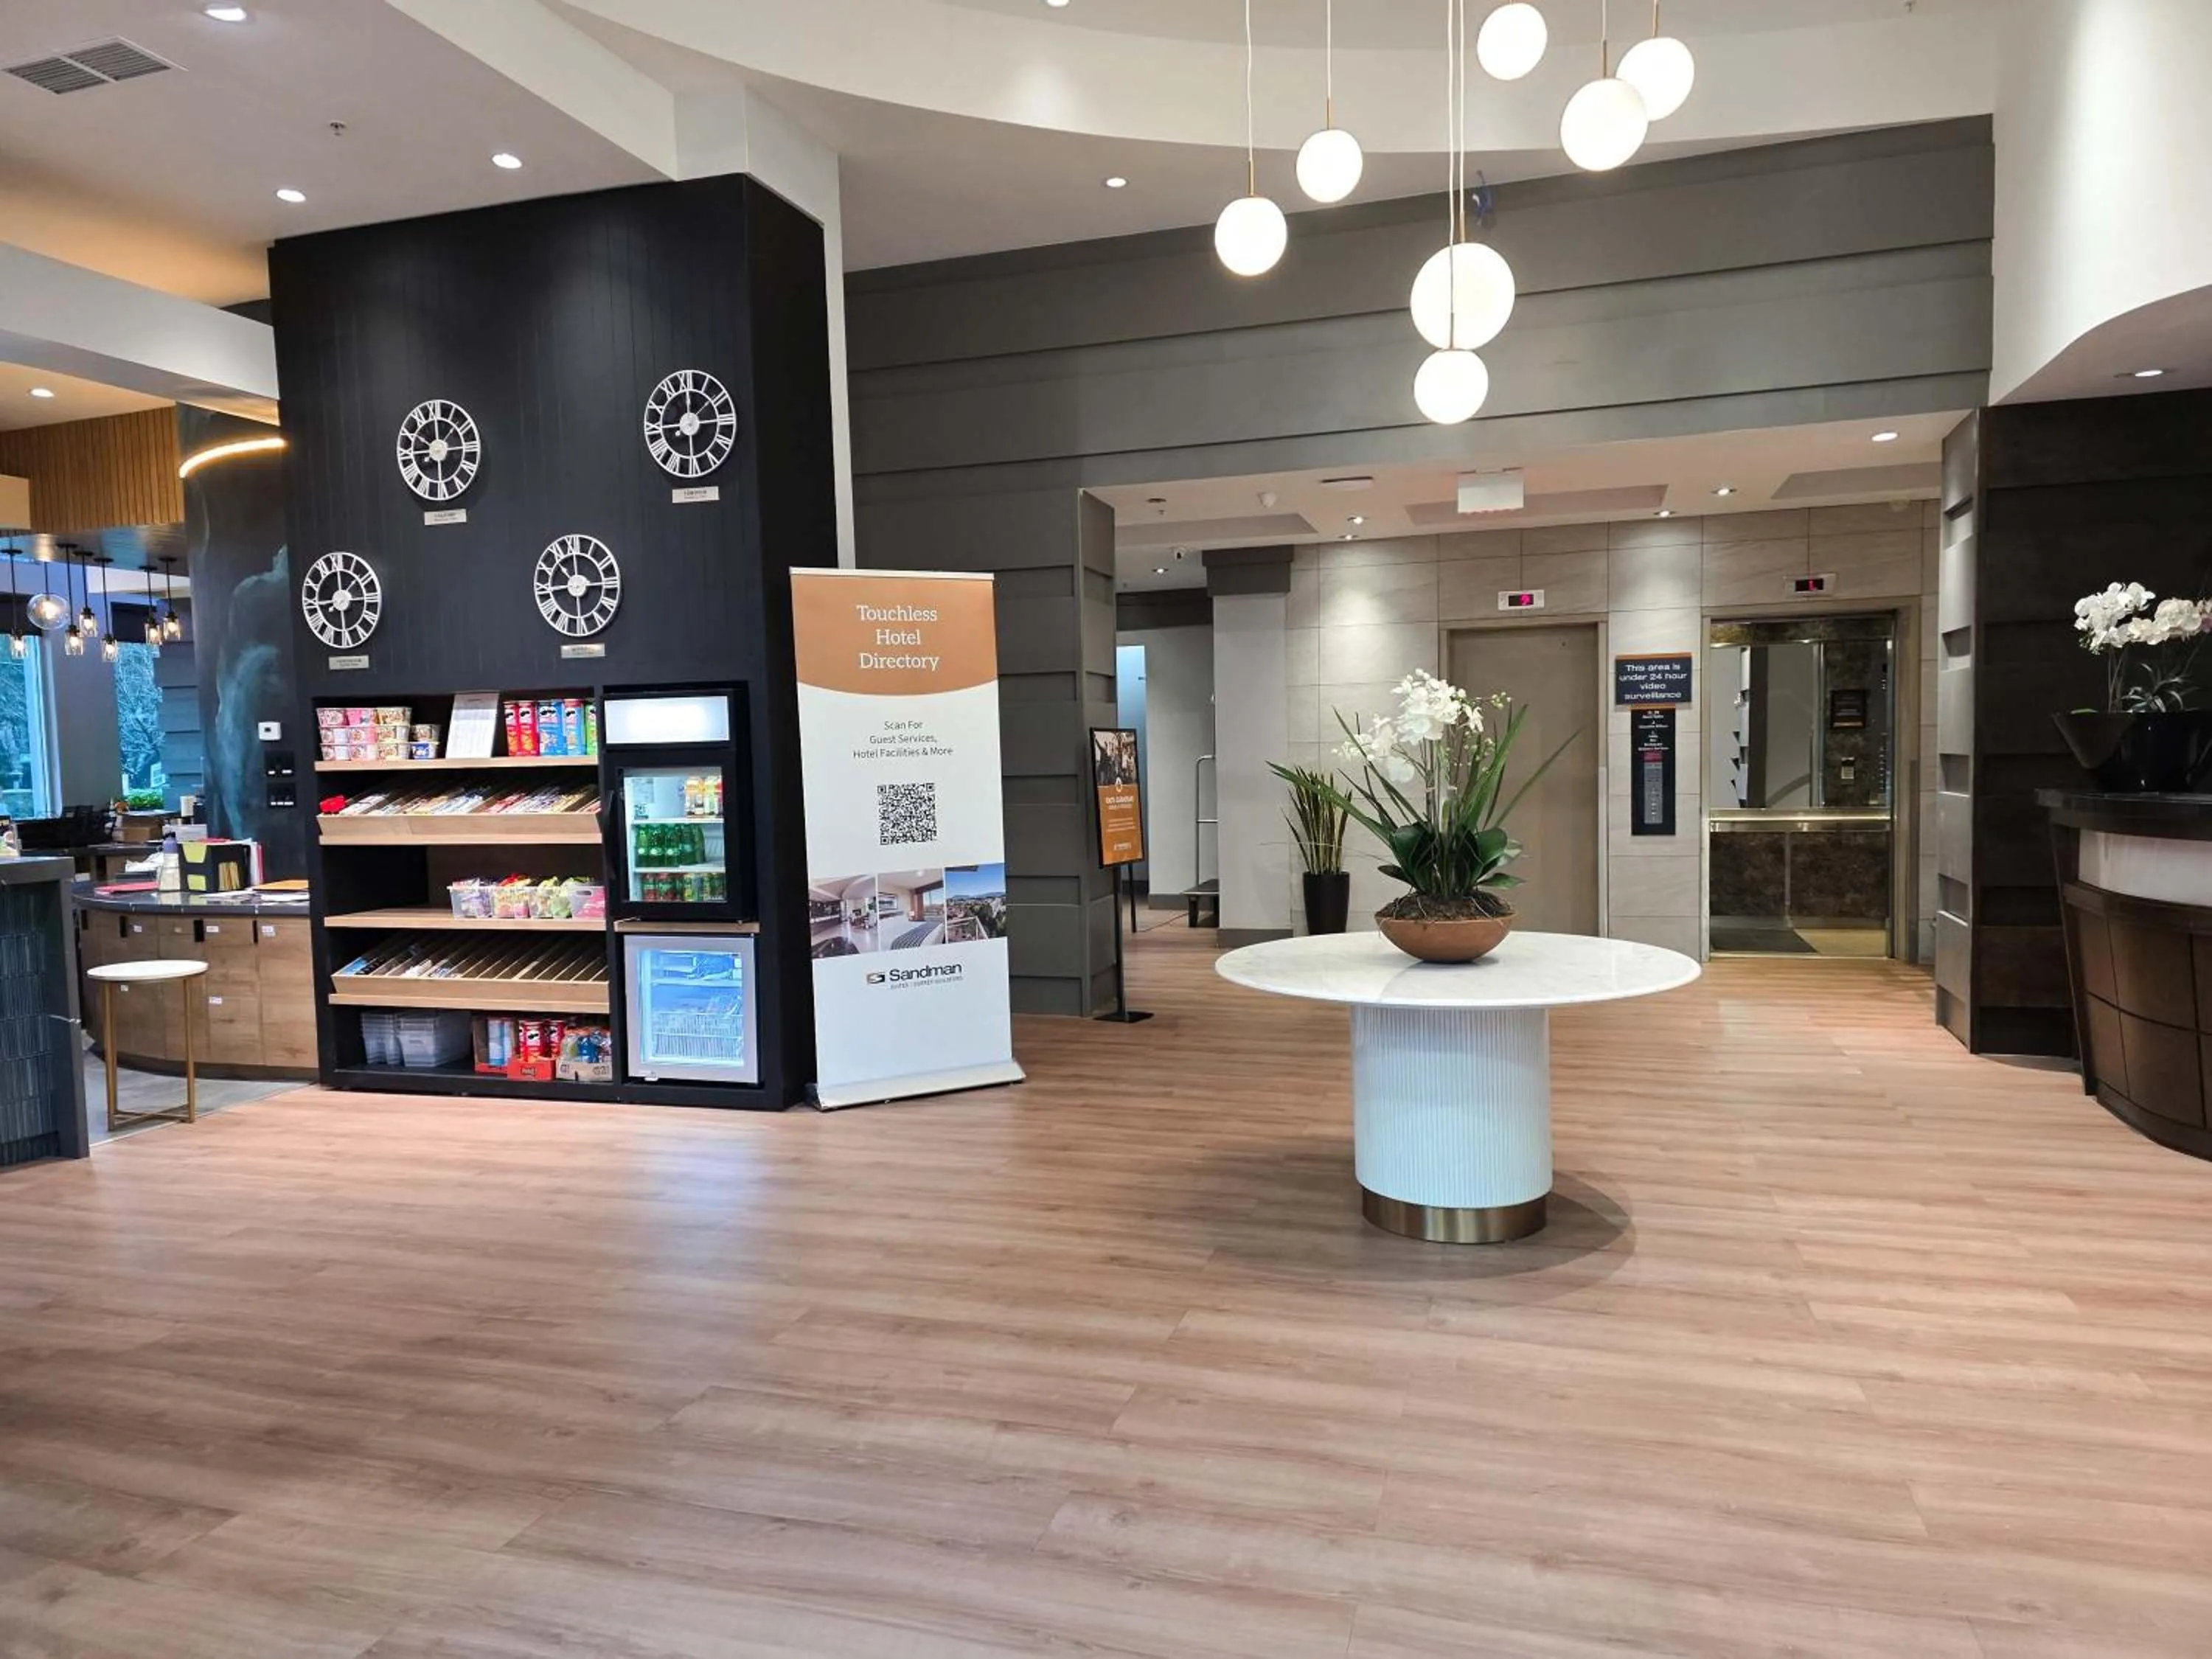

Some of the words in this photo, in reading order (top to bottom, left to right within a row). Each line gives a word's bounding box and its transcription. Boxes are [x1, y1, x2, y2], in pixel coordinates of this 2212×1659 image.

[677, 372, 693, 391] XII
[712, 391, 727, 406] II
[426, 400, 441, 419] XII
[647, 400, 664, 414] X
[718, 414, 734, 425] III
[459, 420, 473, 434] II
[646, 422, 662, 434] IX
[400, 428, 415, 441] X
[464, 441, 479, 451] III
[399, 448, 413, 459] IX
[706, 451, 719, 467] V
[453, 476, 465, 490] V
[565, 535, 580, 554] XII
[330, 554, 343, 569] XII
[537, 562, 552, 575] X
[598, 555, 611, 569] II
[304, 578, 319, 591] X
[360, 571, 373, 585] II
[603, 577, 619, 588] III
[535, 582, 550, 594] IX
[304, 598, 318, 608] IX
[366, 593, 378, 602] III
[594, 611, 605, 626] V
[856, 605, 937, 622] Touchless
[356, 625, 369, 640] V
[876, 629, 921, 645] Hotel
[859, 653, 940, 672] Directory
[884, 721, 906, 730] Scan
[908, 720, 923, 729] For
[869, 734, 896, 744] Guest
[898, 734, 937, 744] Services,
[853, 748, 878, 759] Hotel
[880, 747, 919, 758] Facilities
[922, 748, 928, 756] &
[930, 746, 953, 756] More
[889, 964, 962, 981] Sandman
